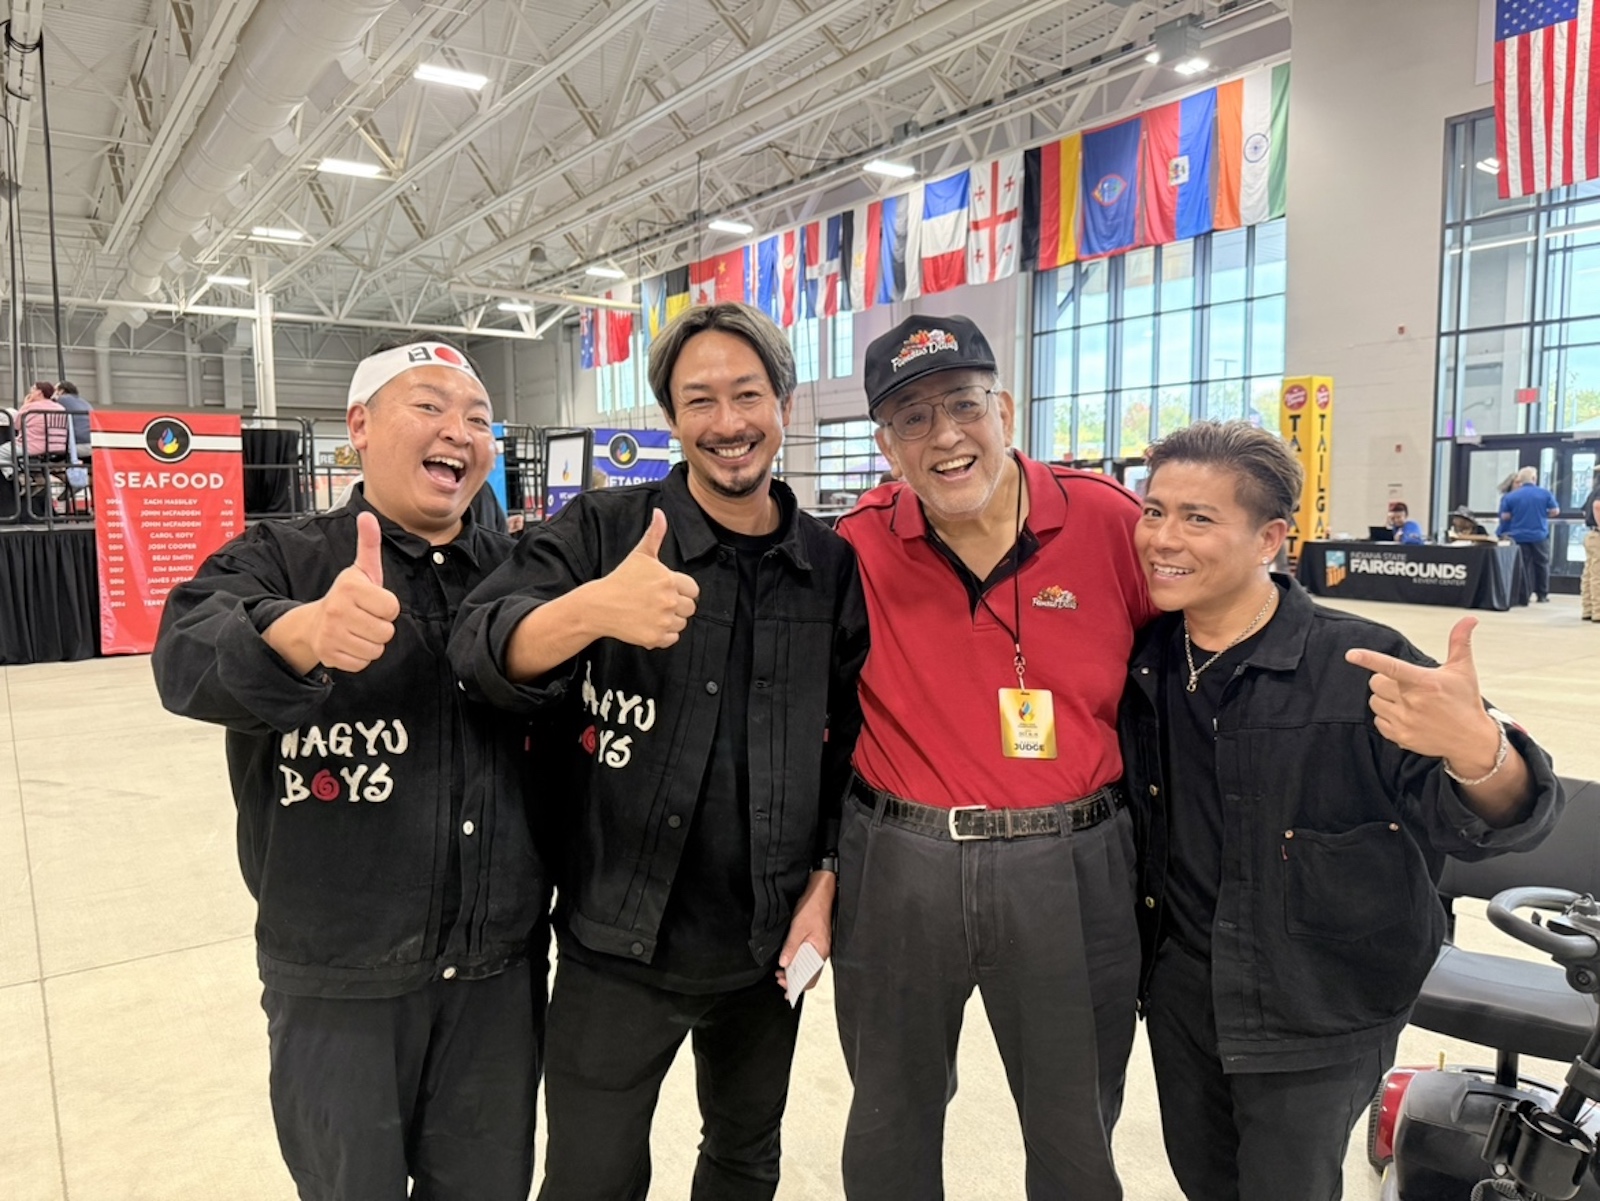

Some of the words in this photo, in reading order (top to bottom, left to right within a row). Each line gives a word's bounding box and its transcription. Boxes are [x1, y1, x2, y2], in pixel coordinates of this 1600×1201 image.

[113, 471, 224, 490] SEAFOOD
[1315, 413, 1327, 540] TAILGA
[140, 509, 161, 517] JOHN
[162, 509, 202, 517] MCFADDEN
[141, 520, 162, 529] JOHN
[162, 520, 202, 528] MCFADDEN
[149, 531, 174, 540] CAROL
[148, 543, 167, 552] JOSH
[1382, 552, 1407, 561] STATE
[1350, 558, 1467, 580] FAIRGROUNDS
[147, 576, 170, 585] JAMES
[1013, 743, 1046, 752] JUDGE
[278, 762, 394, 807] BOYS
